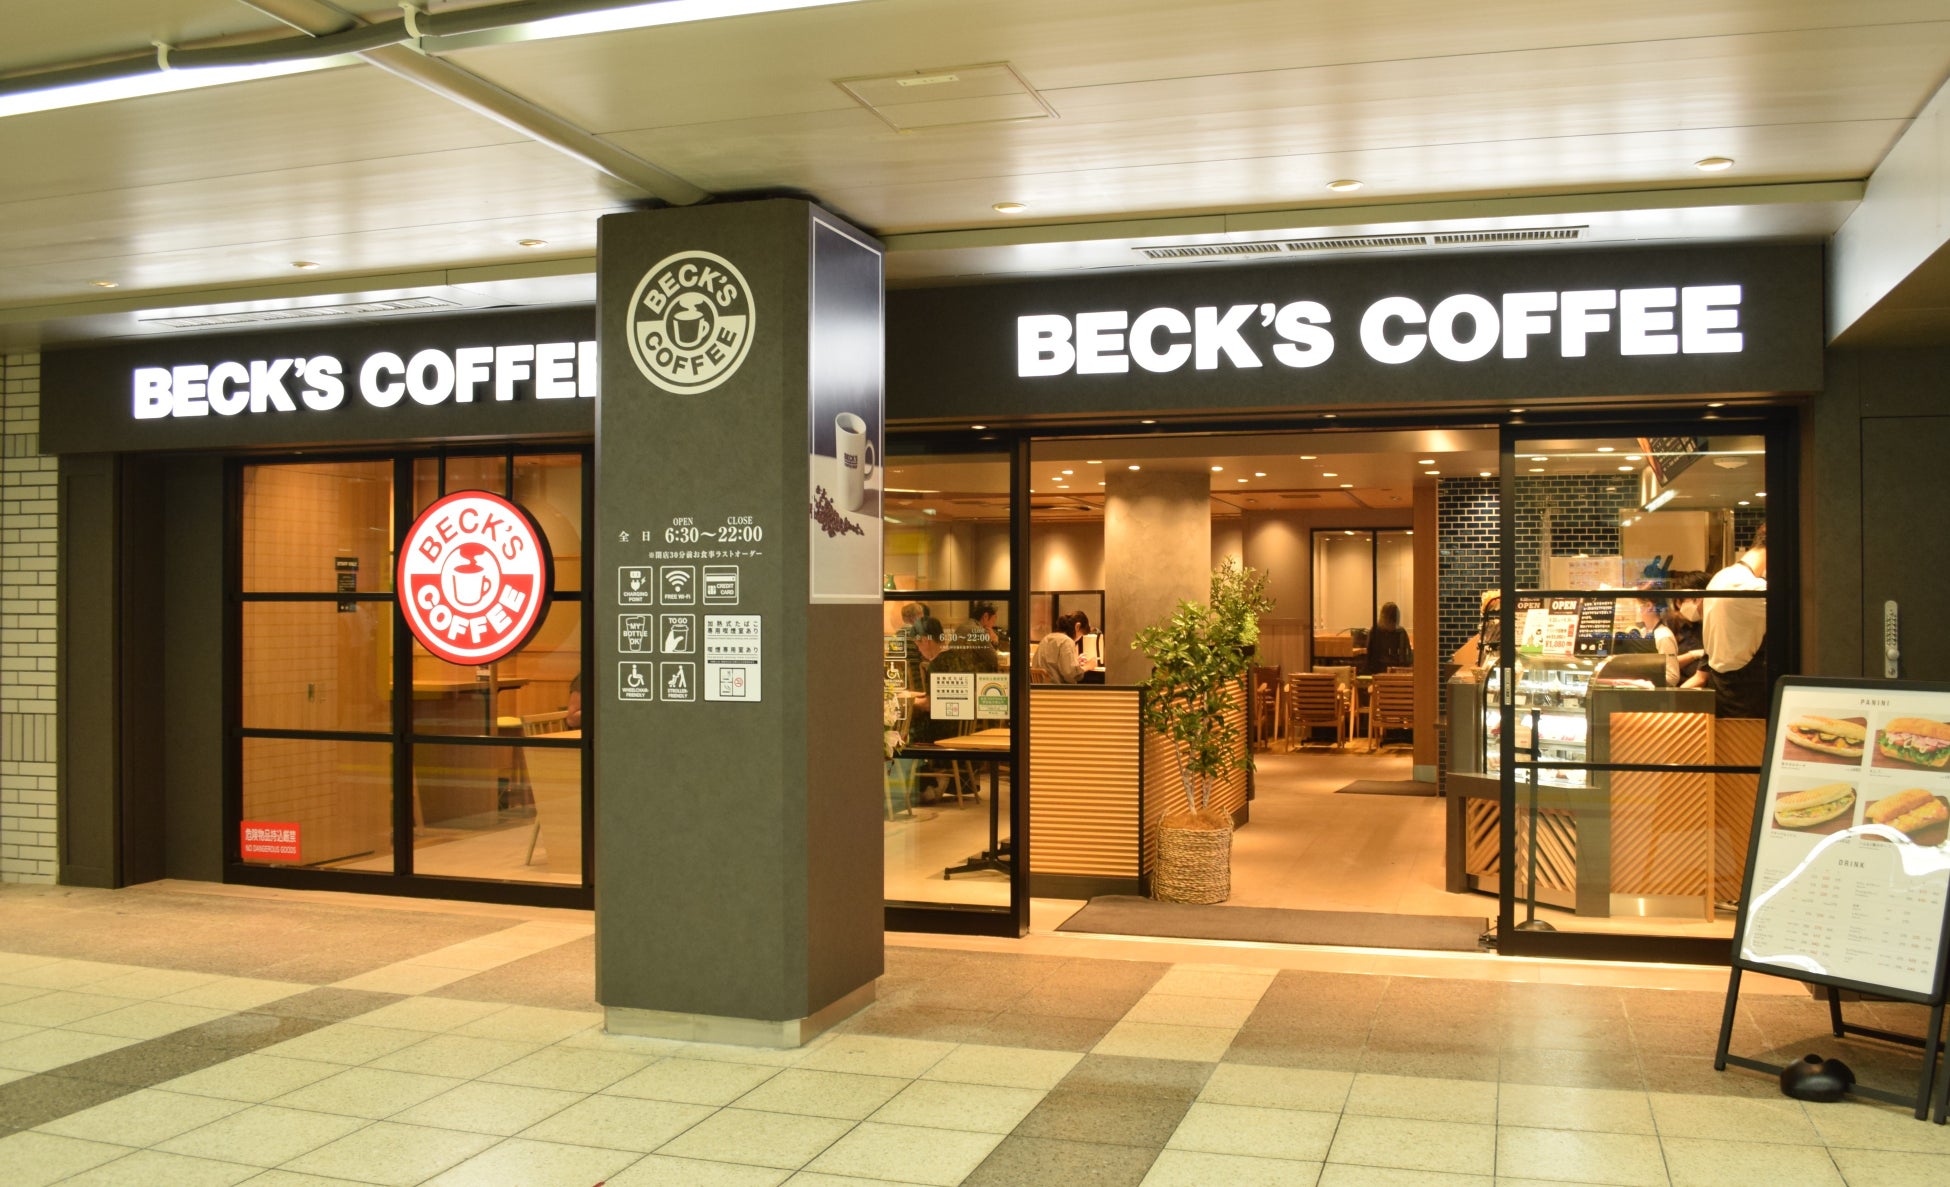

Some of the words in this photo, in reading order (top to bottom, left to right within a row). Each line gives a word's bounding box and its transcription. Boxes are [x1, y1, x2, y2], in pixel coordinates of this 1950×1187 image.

[643, 264, 737, 315] BECK'S
[645, 326, 737, 376] COFFEE
[1017, 300, 1334, 378] BECK'S
[1360, 285, 1744, 365] COFFEE
[133, 355, 345, 420] BECK'S
[419, 508, 523, 563] BECK'S
[673, 517, 694, 526] OPEN
[727, 516, 753, 525] CLOSE
[417, 584, 526, 644] COFFEE
[629, 622, 641, 630] MY
[1552, 600, 1577, 610] OPEN
[1860, 699, 1891, 707] PANINI
[1838, 859, 1865, 869] DRINK
